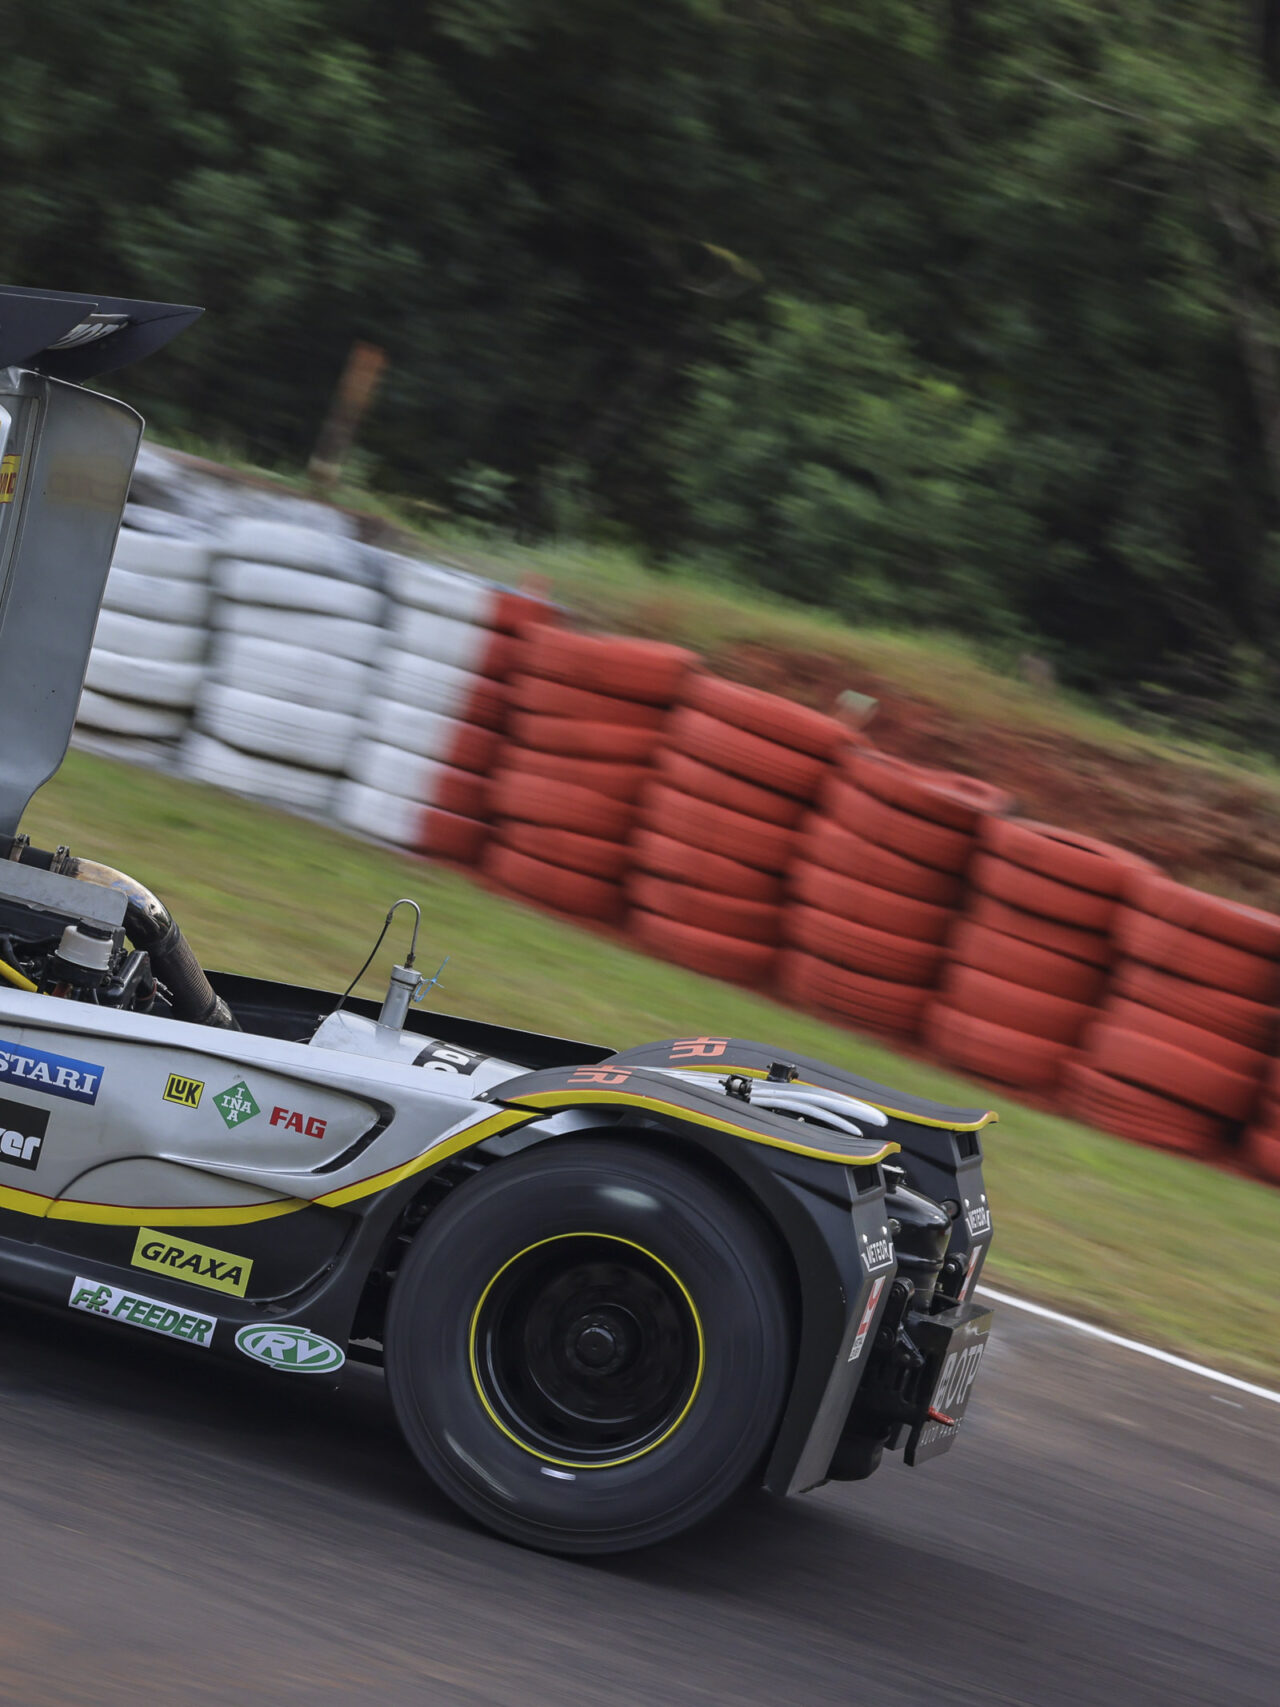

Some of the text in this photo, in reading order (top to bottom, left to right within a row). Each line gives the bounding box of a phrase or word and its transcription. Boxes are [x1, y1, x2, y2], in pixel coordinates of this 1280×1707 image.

[269, 1106, 328, 1140] FAG
[140, 1241, 243, 1286] GRAXA
[111, 1296, 213, 1344] FEEDER
[256, 1333, 332, 1363] RV
